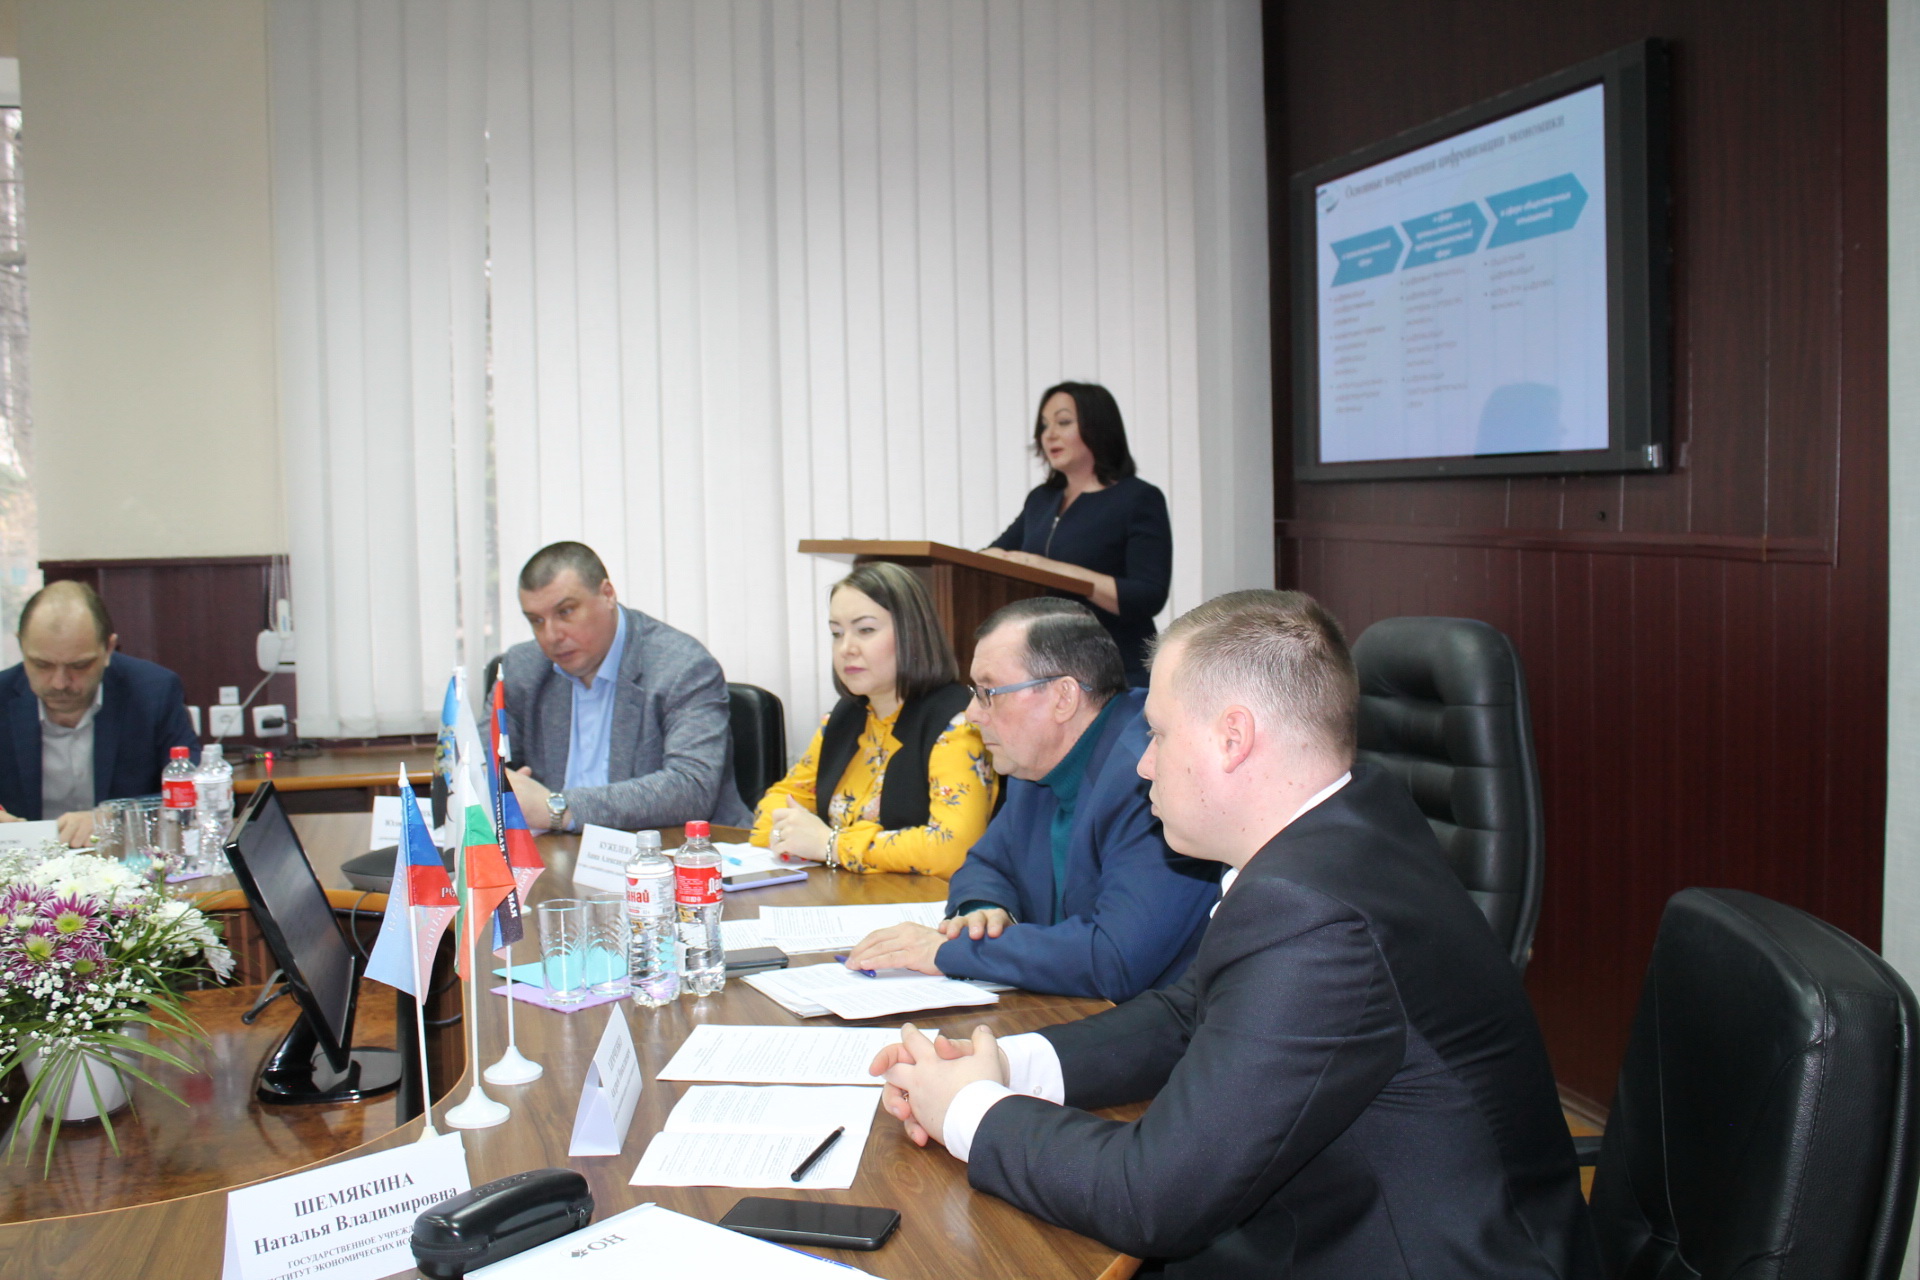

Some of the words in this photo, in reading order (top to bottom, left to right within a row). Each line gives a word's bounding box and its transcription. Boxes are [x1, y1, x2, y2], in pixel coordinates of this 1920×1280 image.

[293, 1172, 415, 1218] ШЕМЯКИНА
[252, 1222, 332, 1256] Наталья
[335, 1187, 458, 1232] Владимировна
[267, 1267, 311, 1280] СТИТУТ
[312, 1241, 395, 1273] ЭКОНОМИЧЕСКИХ
[287, 1236, 377, 1269] ГОСУДАРСТВЕННОЕ
[378, 1225, 415, 1241] УЧРЕЖД
